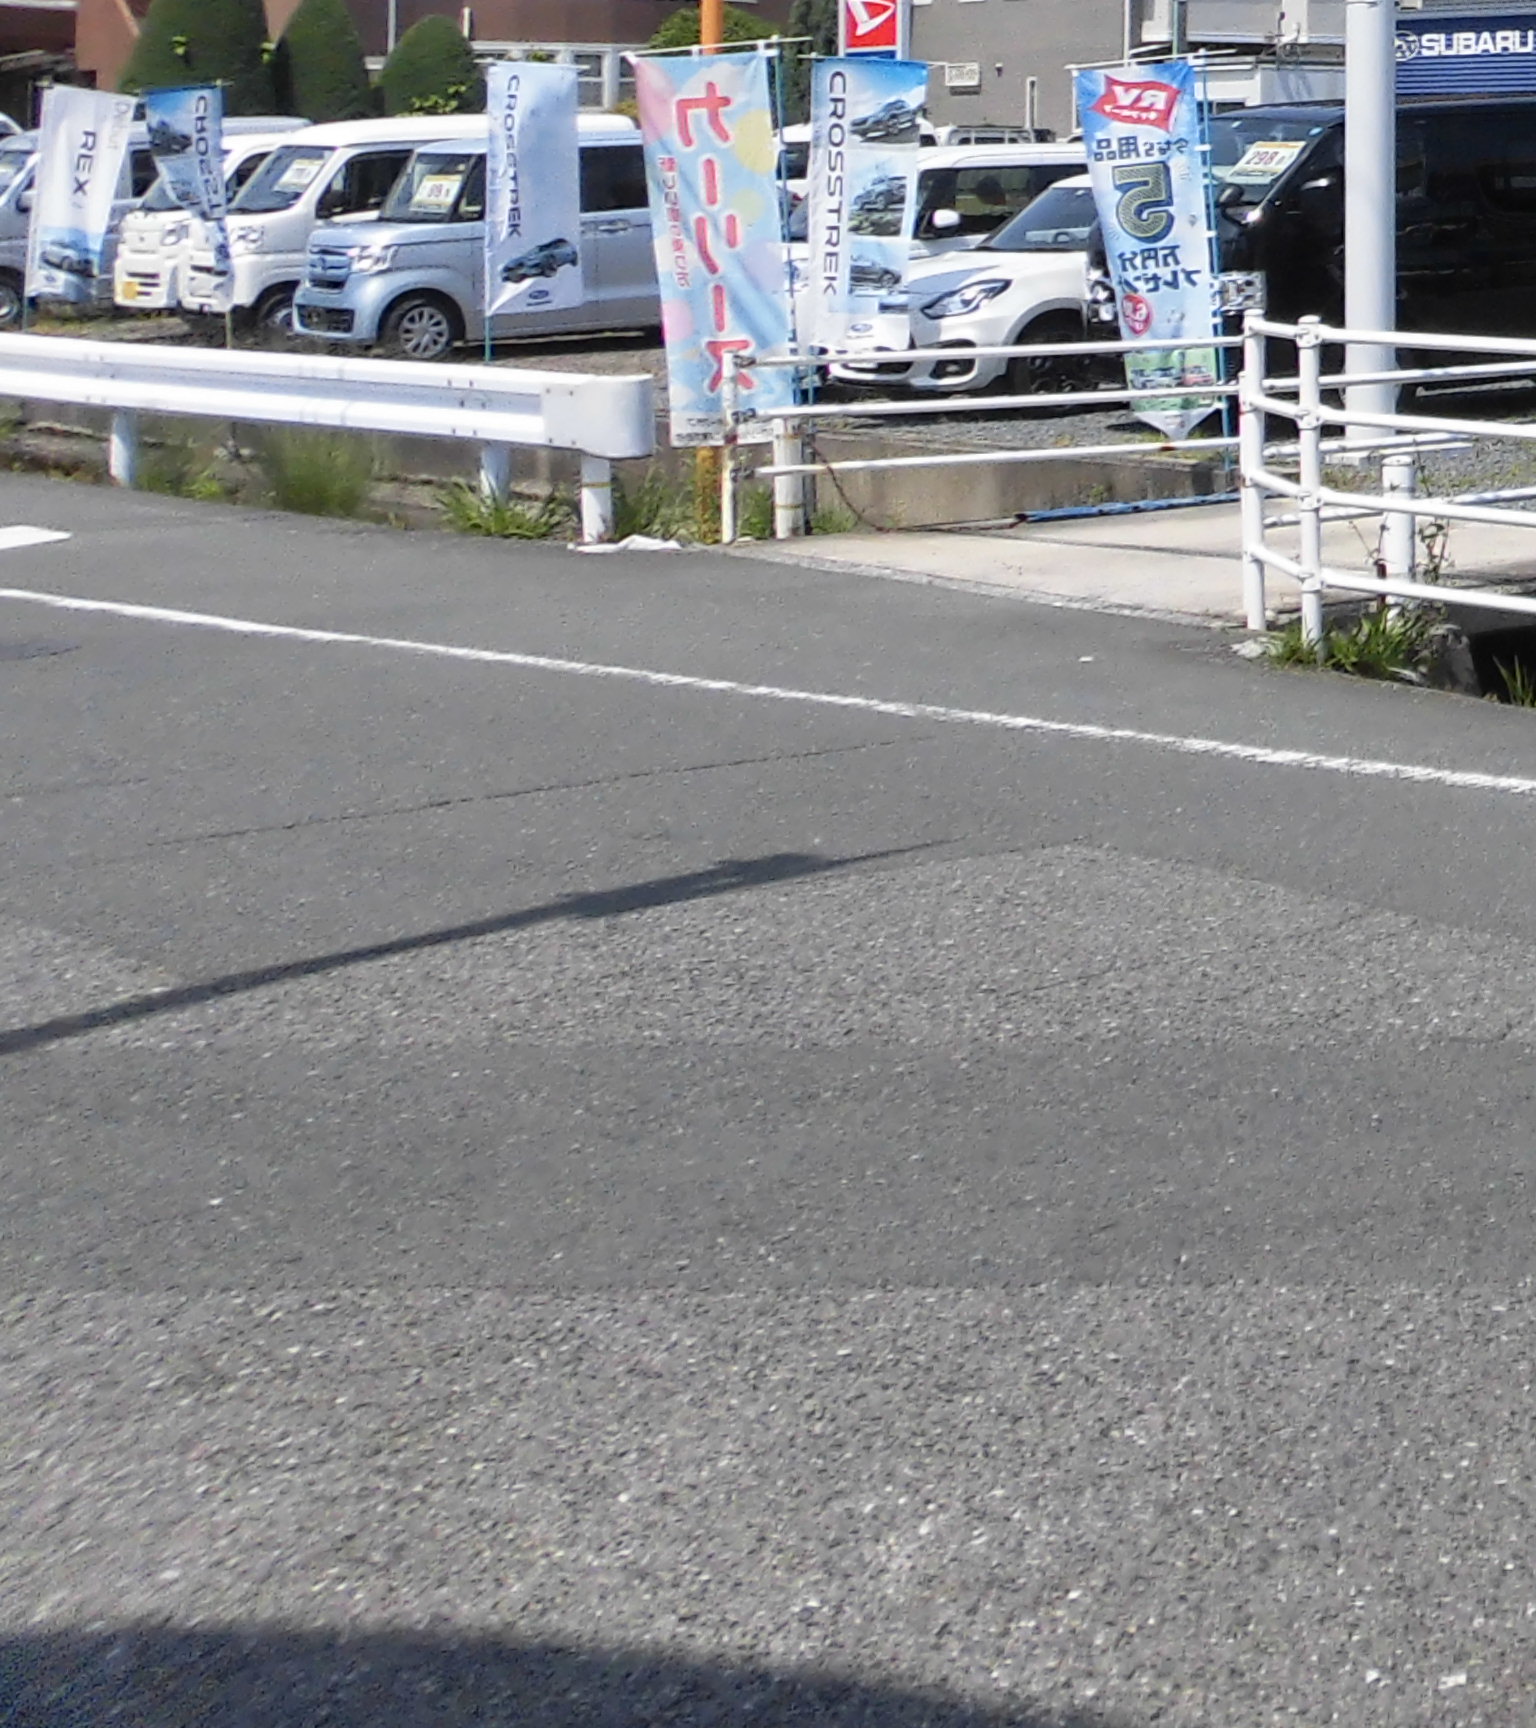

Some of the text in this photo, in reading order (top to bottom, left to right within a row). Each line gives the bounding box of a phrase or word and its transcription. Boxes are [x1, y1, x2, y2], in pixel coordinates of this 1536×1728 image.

[1421, 30, 1533, 56] SUBARU
[72, 130, 97, 197] REX
[822, 71, 847, 296] CROSSTREK
